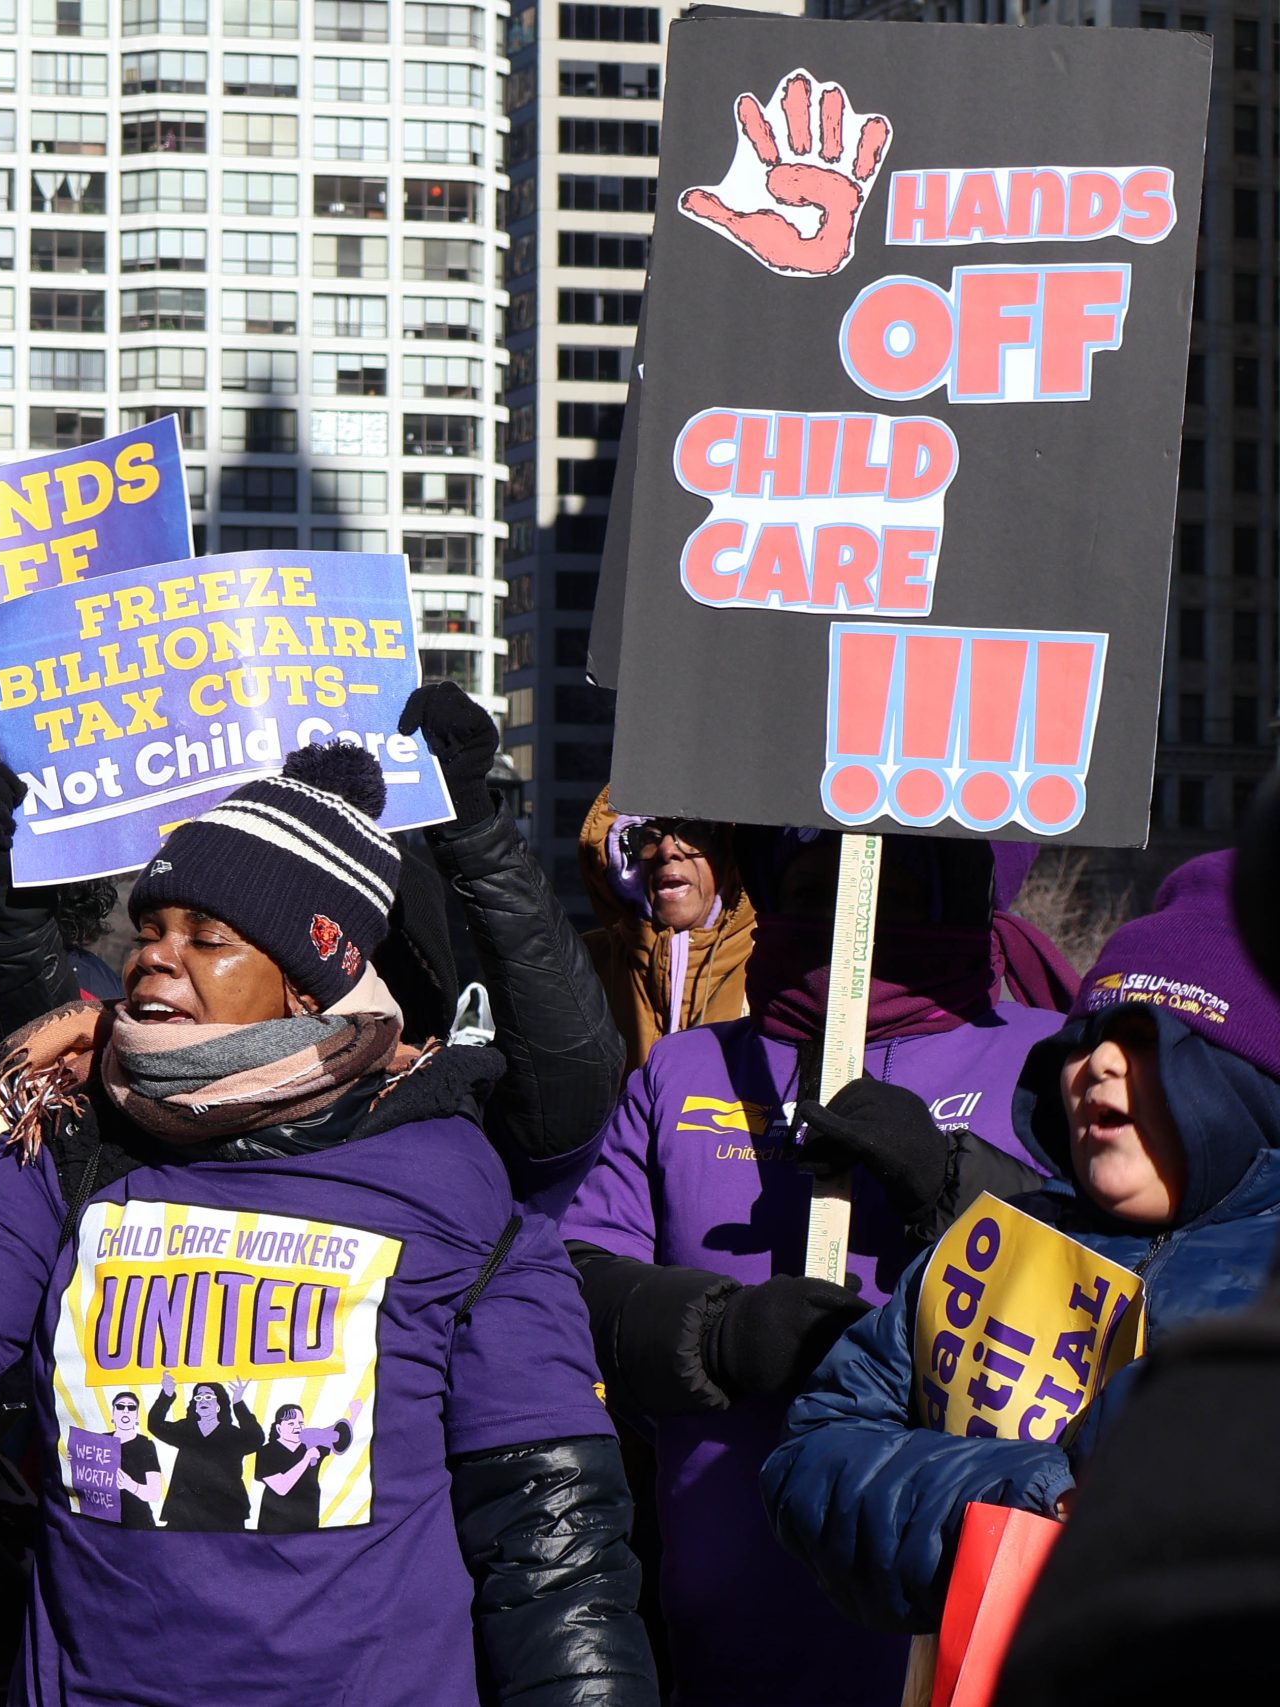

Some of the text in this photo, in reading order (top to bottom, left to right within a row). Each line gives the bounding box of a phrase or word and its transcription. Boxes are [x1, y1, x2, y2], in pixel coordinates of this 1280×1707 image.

[842, 264, 1131, 402] OFF
[675, 408, 958, 504] CHILD
[682, 517, 940, 614] CARE
[73, 566, 317, 641] FREEZE
[34, 686, 169, 755] TAX
[17, 759, 124, 816] Not
[134, 717, 282, 787] Child
[850, 966, 866, 1000] VISIT
[936, 1122, 970, 1132] ansas
[96, 1224, 359, 1271] CHILD CARE WORKERS
[93, 1270, 341, 1371] UNITED
[75, 1443, 112, 1465] WE'RE
[75, 1464, 114, 1488] WORTH
